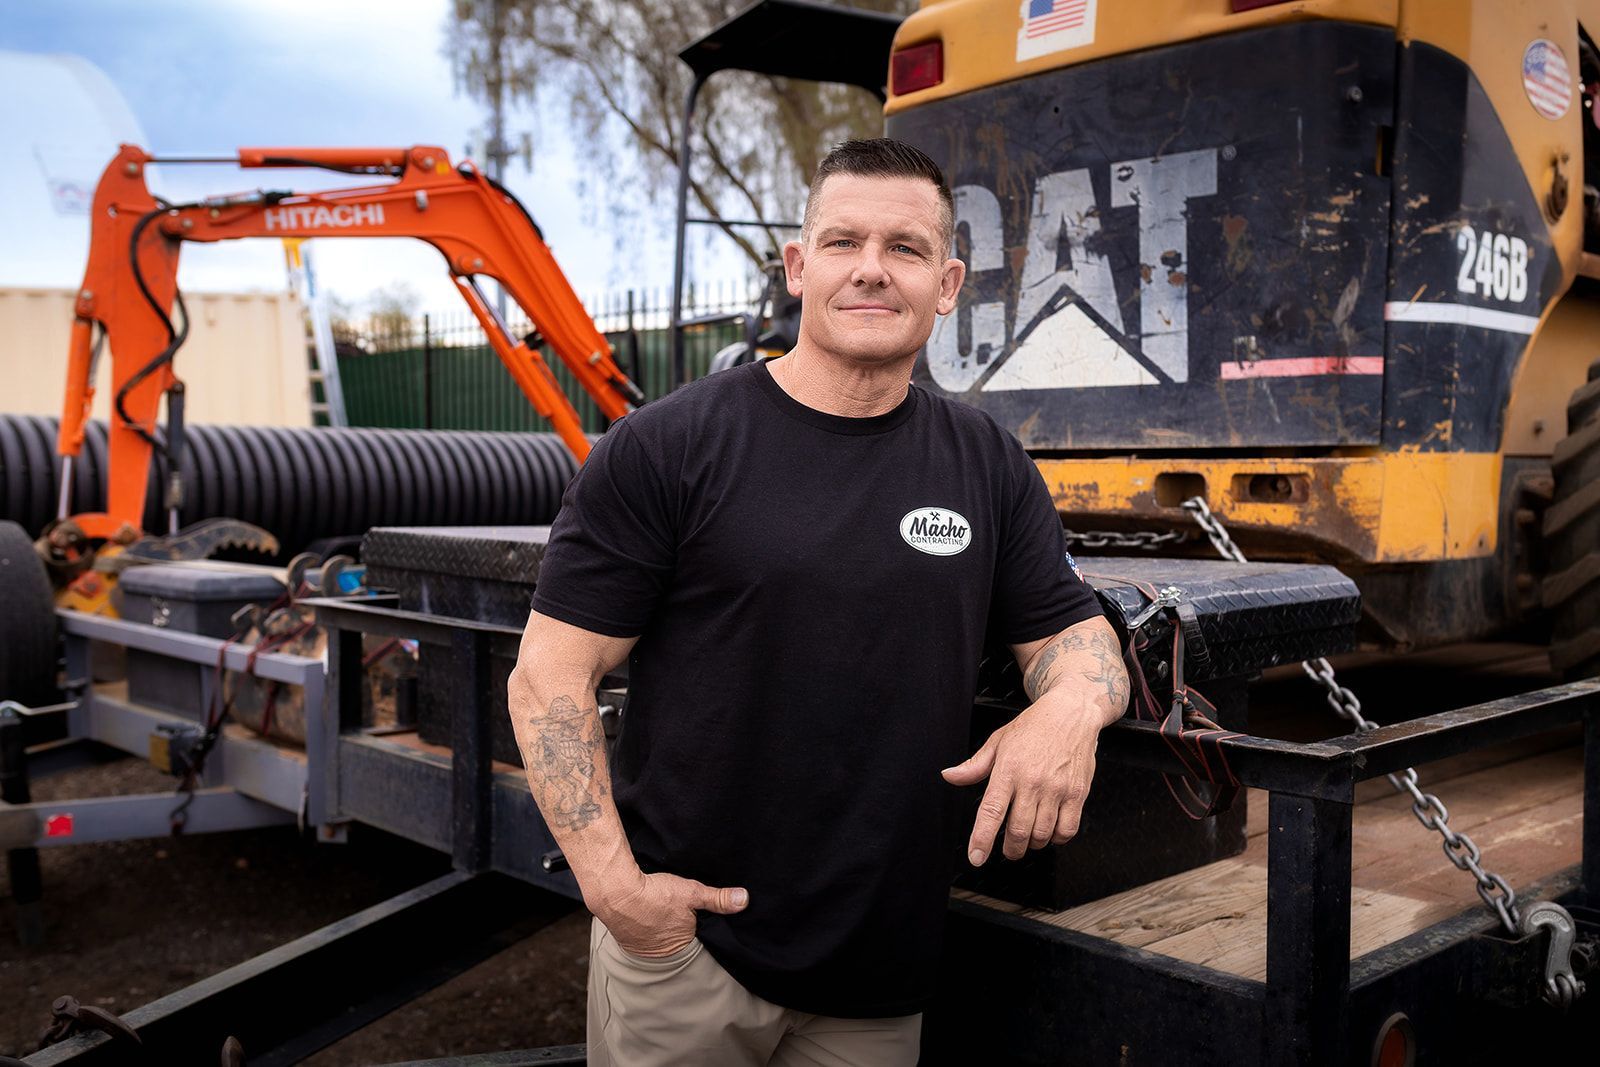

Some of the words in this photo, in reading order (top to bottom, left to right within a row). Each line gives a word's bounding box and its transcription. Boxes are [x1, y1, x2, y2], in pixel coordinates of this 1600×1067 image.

[264, 203, 385, 231] HITACHI
[926, 149, 1218, 393] CAT
[1457, 225, 1528, 303] 246B
[909, 516, 968, 539] Macho
[910, 536, 964, 546] CONTRACTING
